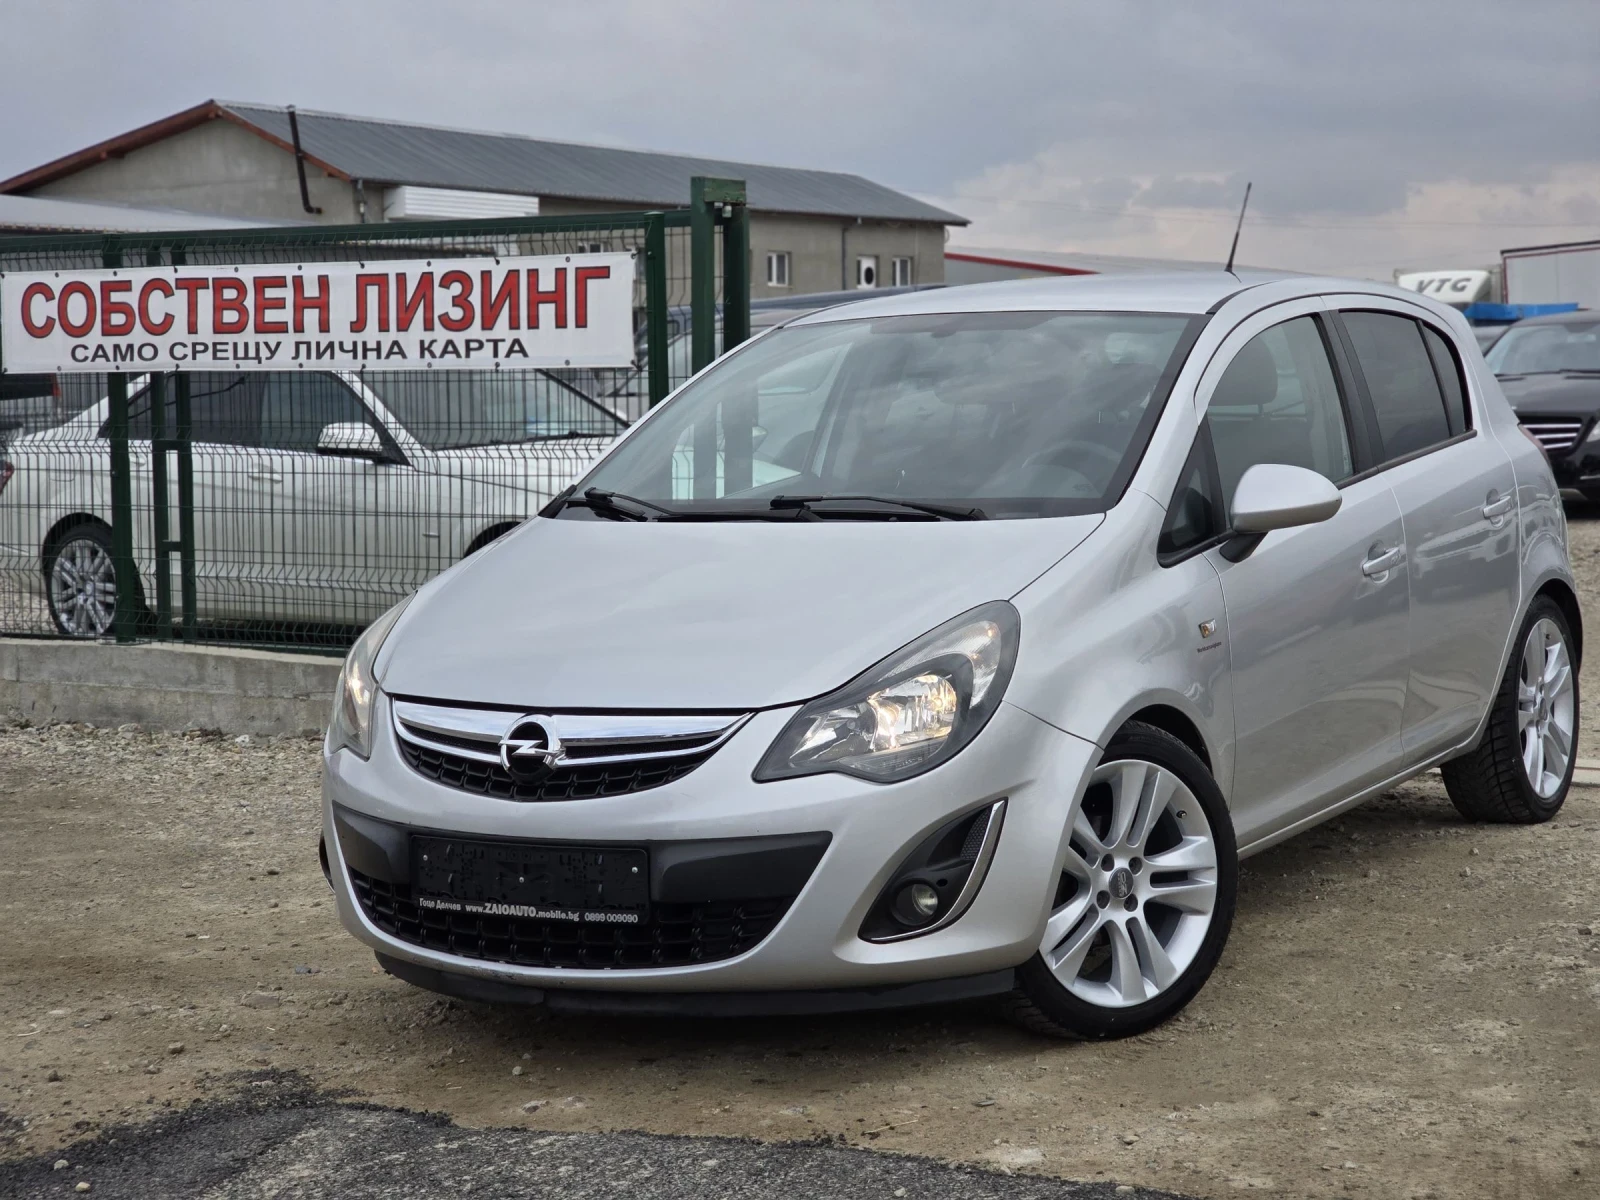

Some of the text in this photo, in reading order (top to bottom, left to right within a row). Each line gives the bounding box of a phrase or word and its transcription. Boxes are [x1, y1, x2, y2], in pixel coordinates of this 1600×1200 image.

[1415, 278, 1472, 293] VTG
[21, 266, 610, 339] СОБСТВЕН ЛИЗИНГ
[71, 338, 530, 364] САМО СРЕЩУ ЛИЧНА КАРТА
[419, 897, 435, 908] Гоце
